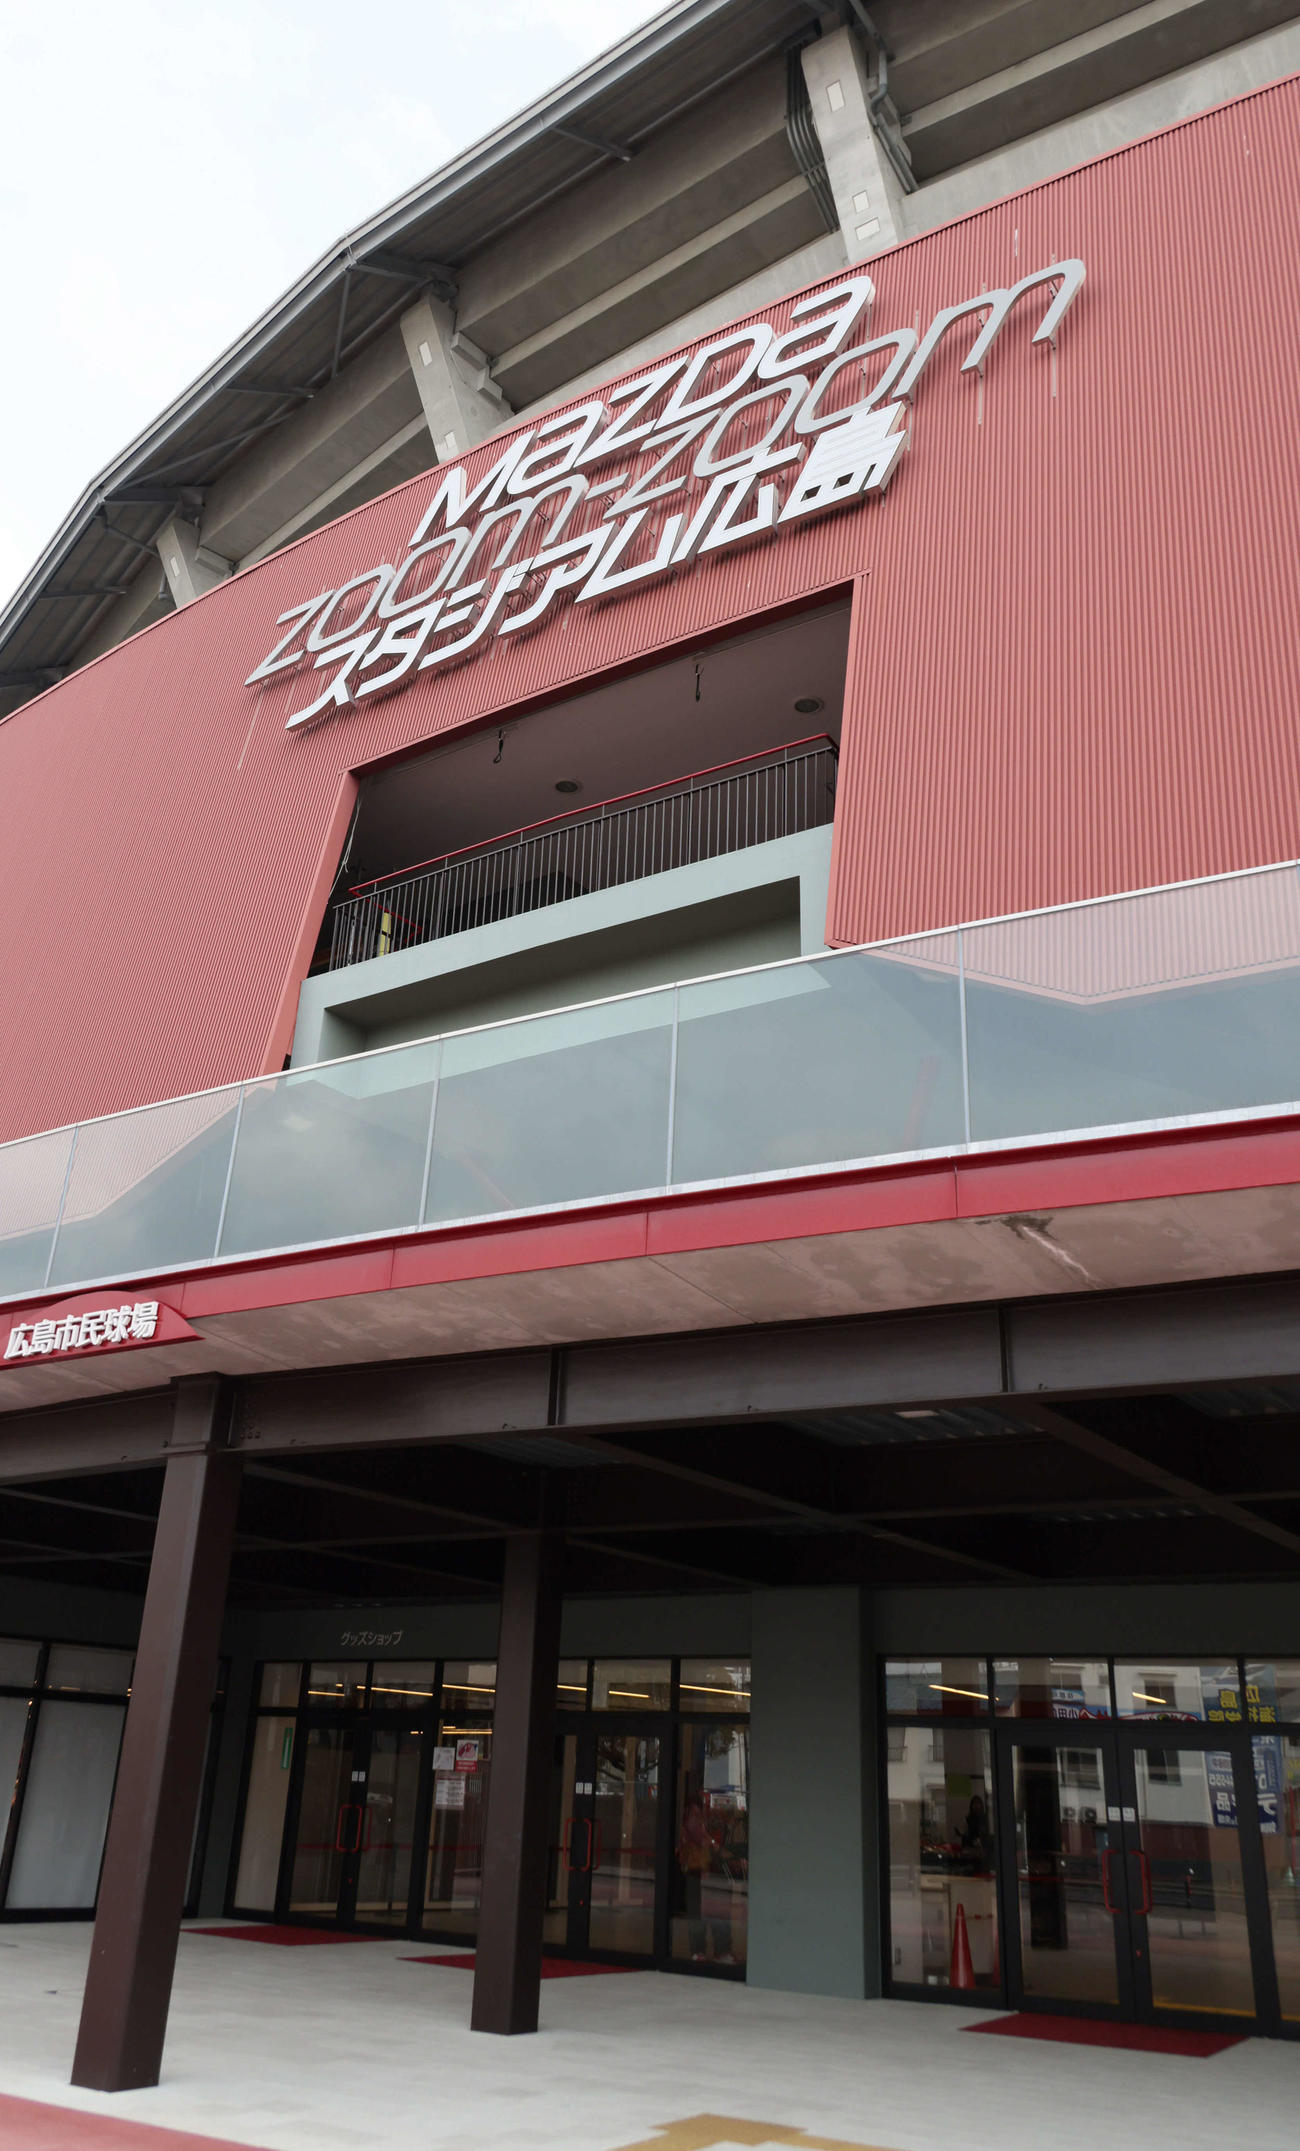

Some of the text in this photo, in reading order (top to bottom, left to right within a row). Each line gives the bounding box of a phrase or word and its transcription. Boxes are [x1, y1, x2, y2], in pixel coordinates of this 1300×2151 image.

[3, 1301, 159, 1359] 広島市民球場
[340, 1630, 403, 1646] グッズショップ
